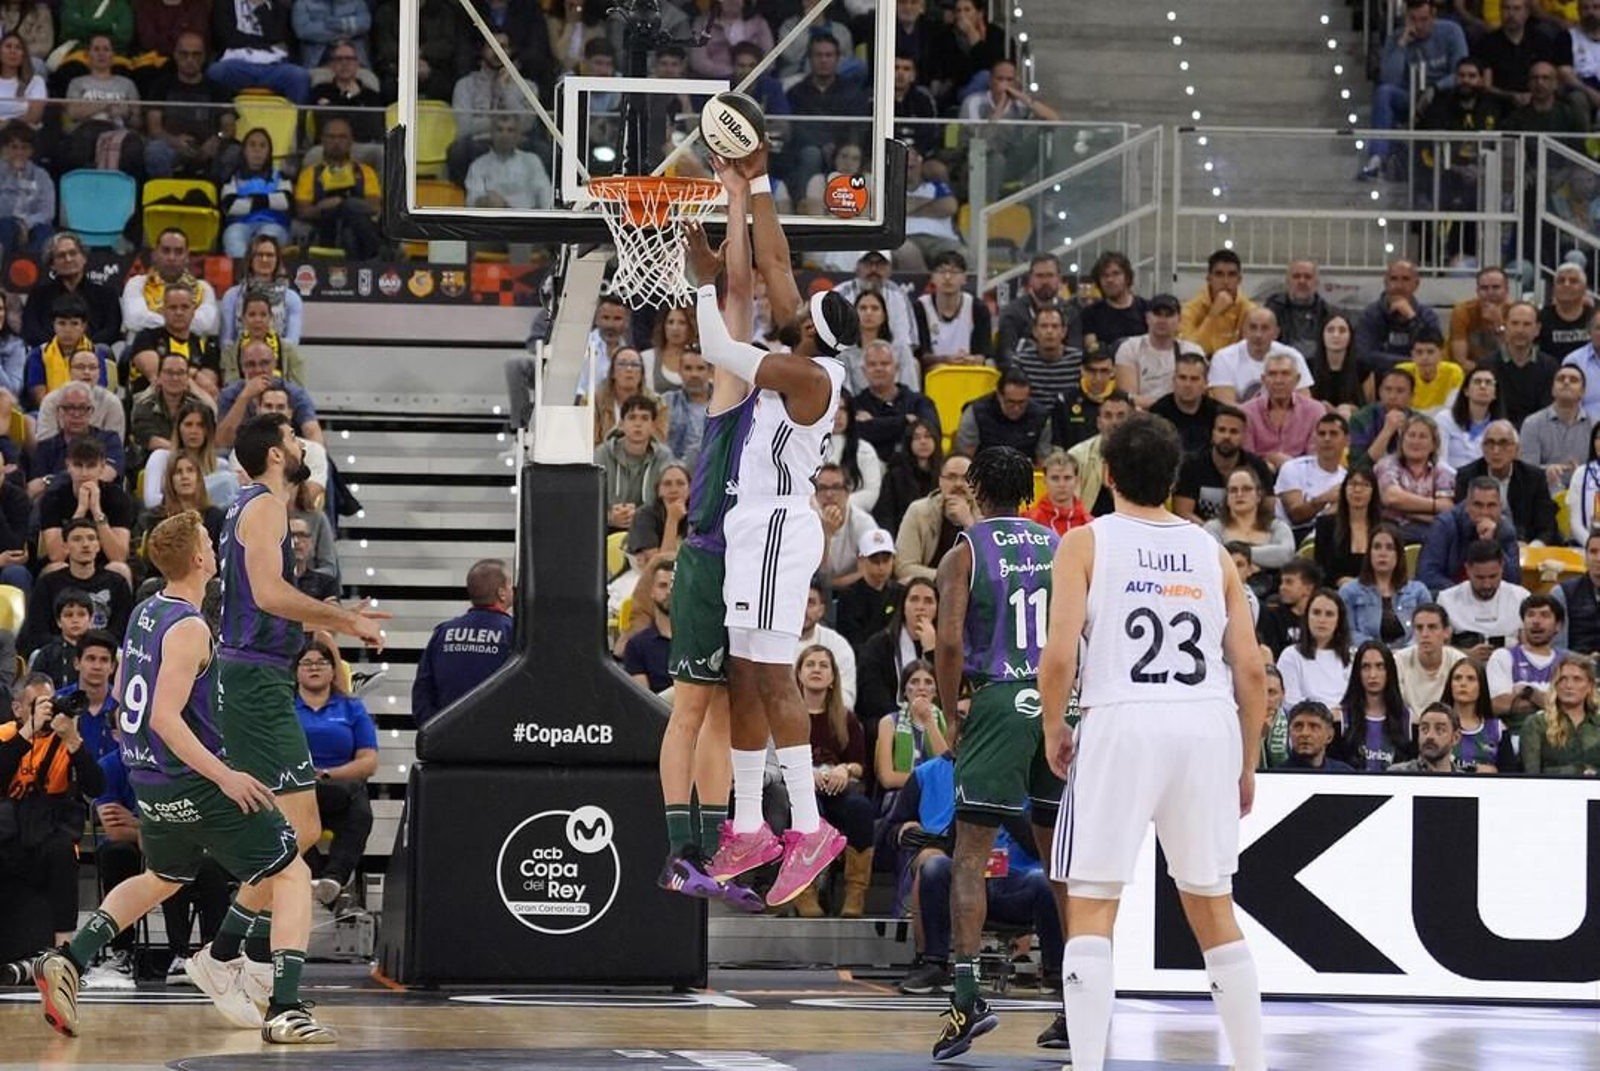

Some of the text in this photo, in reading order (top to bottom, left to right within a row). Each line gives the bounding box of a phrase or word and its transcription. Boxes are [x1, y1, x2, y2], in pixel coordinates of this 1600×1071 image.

[719, 109, 752, 148] Wilson
[992, 529, 1050, 546] Carter
[1137, 548, 1194, 573] LLULL
[1125, 581, 1203, 599] AUTOHERO
[1009, 588, 1047, 649] 11
[444, 627, 502, 643] EULEN
[443, 643, 499, 654] SEGURIDAD
[1125, 607, 1206, 686] 23
[120, 674, 148, 734] 9
[513, 723, 613, 748] #CopaACB
[154, 798, 195, 812] COSTA
[532, 847, 563, 860] acb
[520, 859, 578, 880] Copa
[523, 880, 586, 902] del Rey
[514, 903, 537, 913] Gran
[538, 904, 575, 914] Canaria
